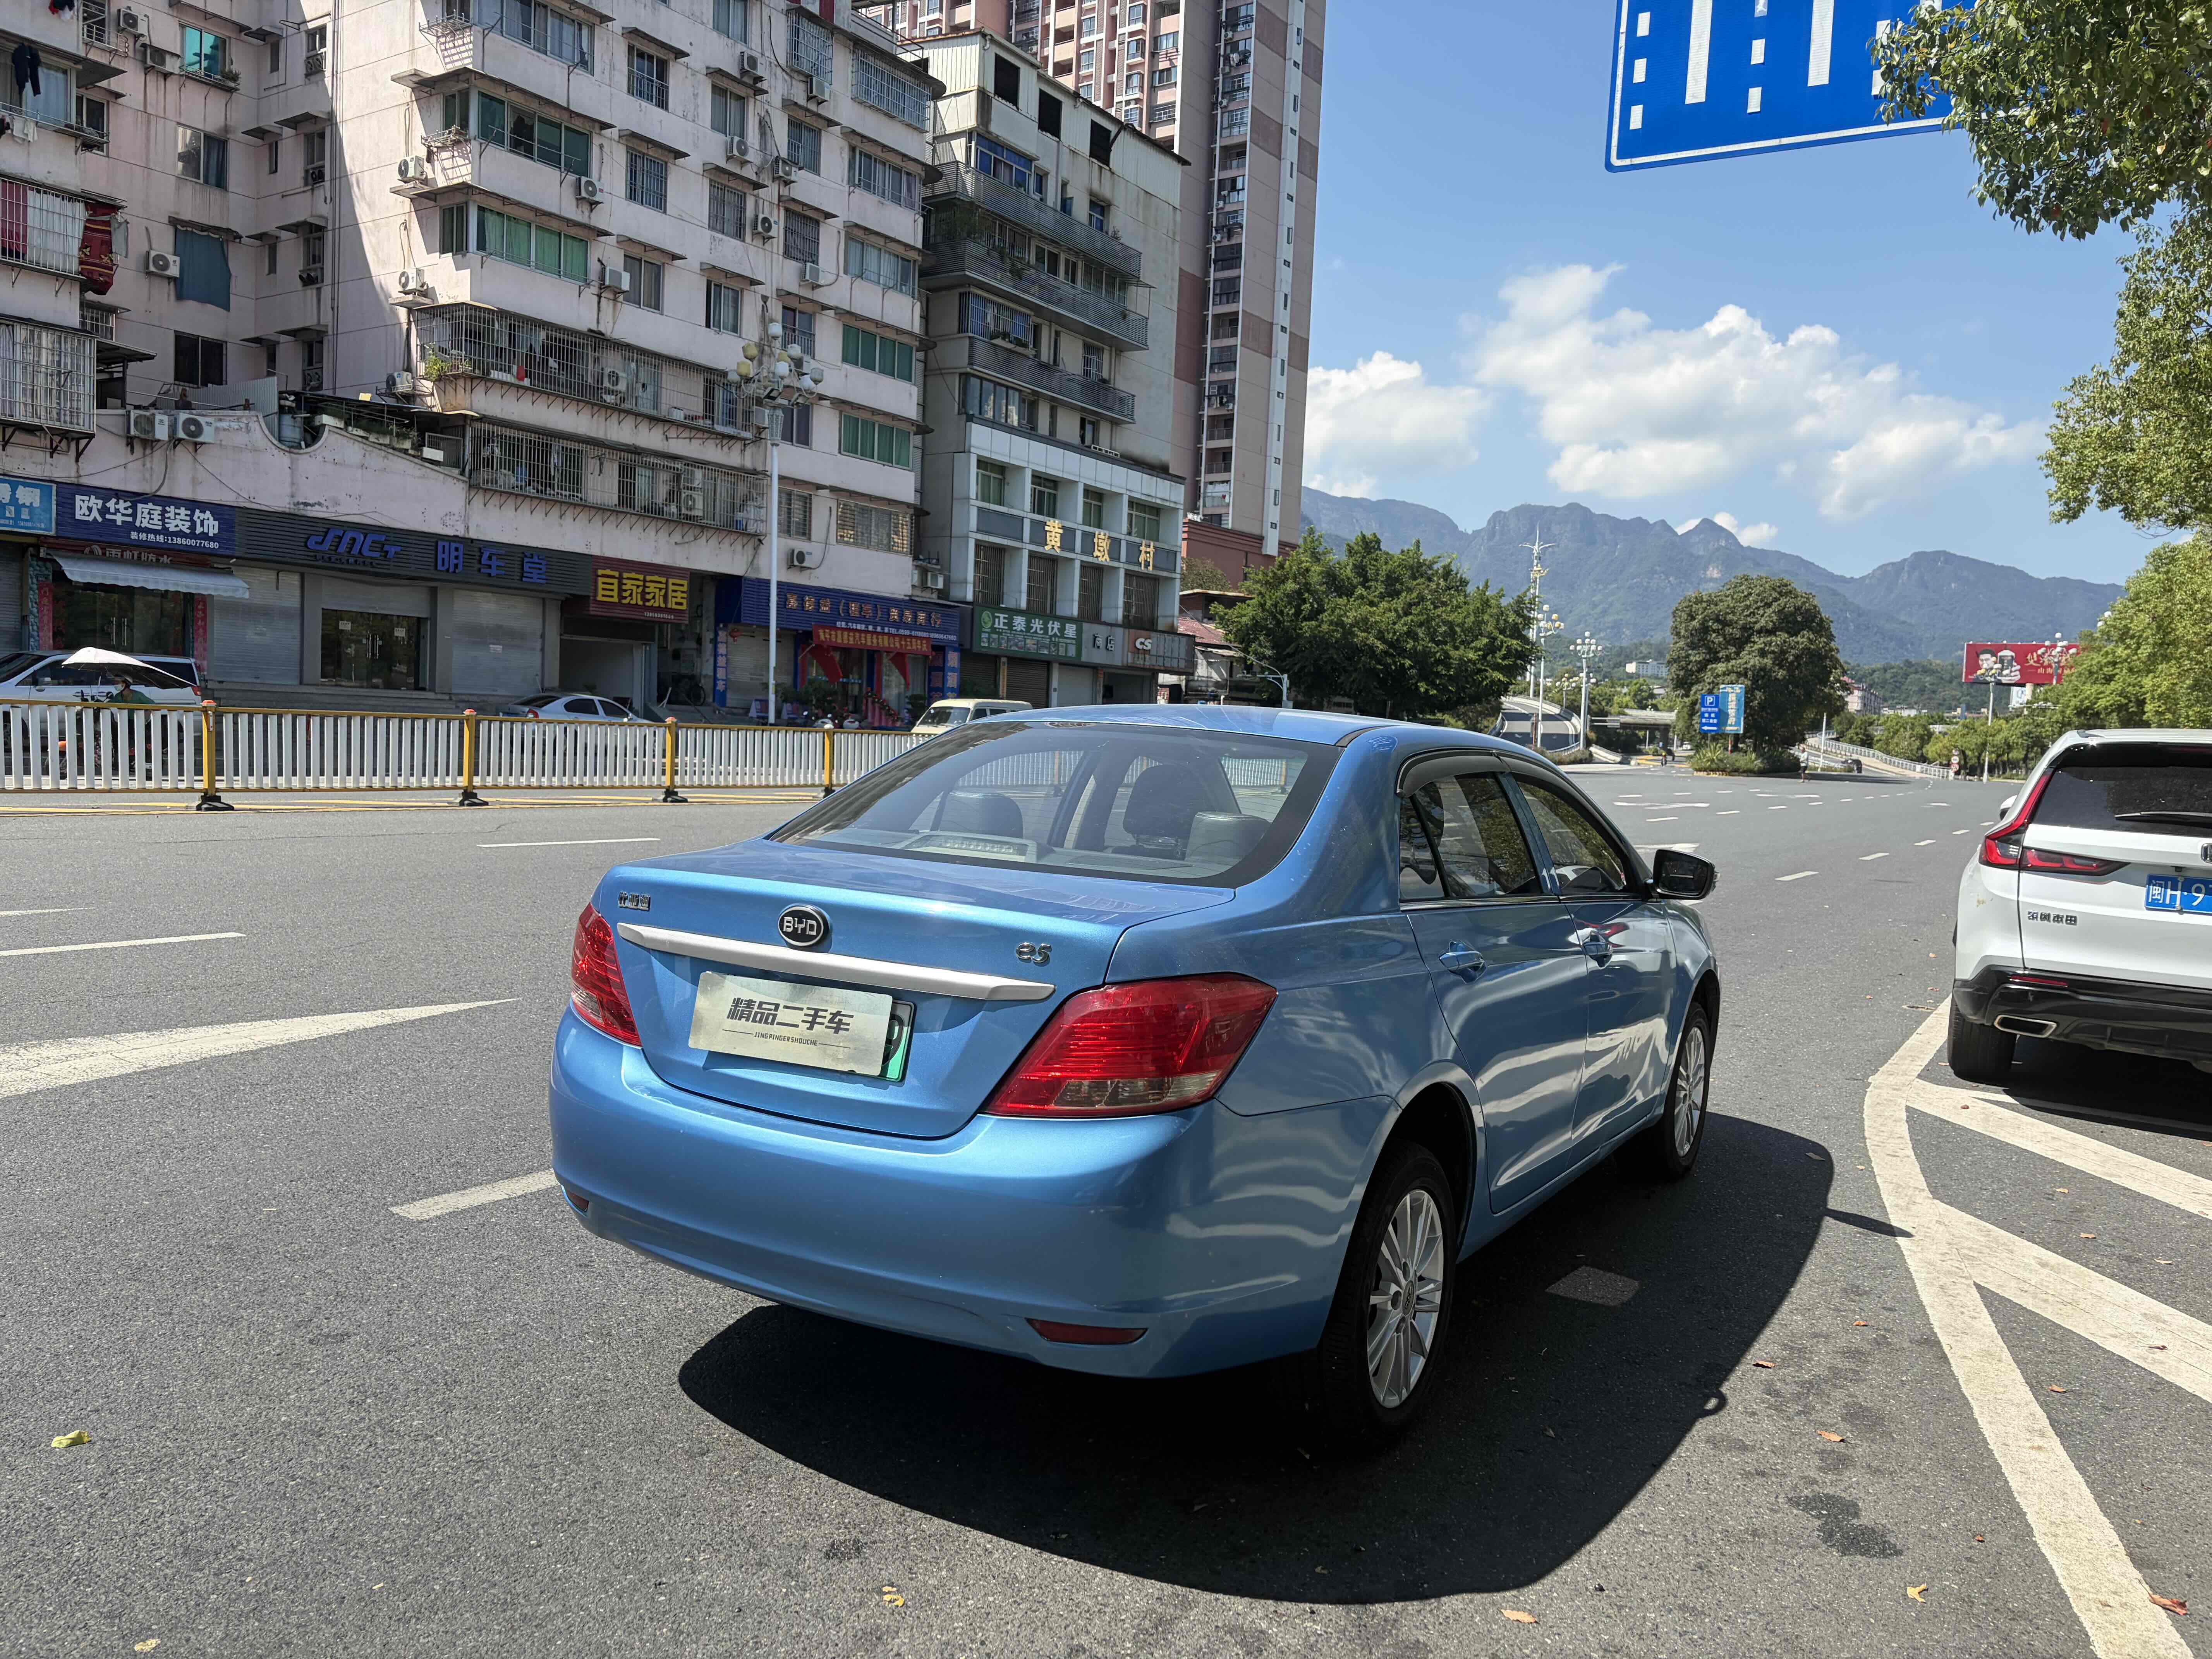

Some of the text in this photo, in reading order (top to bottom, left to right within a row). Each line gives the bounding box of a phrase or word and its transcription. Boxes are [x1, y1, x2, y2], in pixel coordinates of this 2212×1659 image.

[75, 495, 218, 536] 欧华庭装饰
[1044, 520, 1155, 570] 黄墩村
[437, 541, 548, 584] 明车堂
[596, 569, 688, 610] 宜家家居
[994, 613, 1077, 639] 正泰光伏星
[1707, 697, 1713, 705] P
[2148, 880, 2212, 909] 闽H·9
[783, 916, 817, 936] BYD
[2027, 910, 2078, 926] 东风本田
[1016, 942, 1052, 963] e5
[726, 997, 854, 1035] 精品二手车
[754, 1031, 818, 1046] JINGPINGERSHOUCHE
